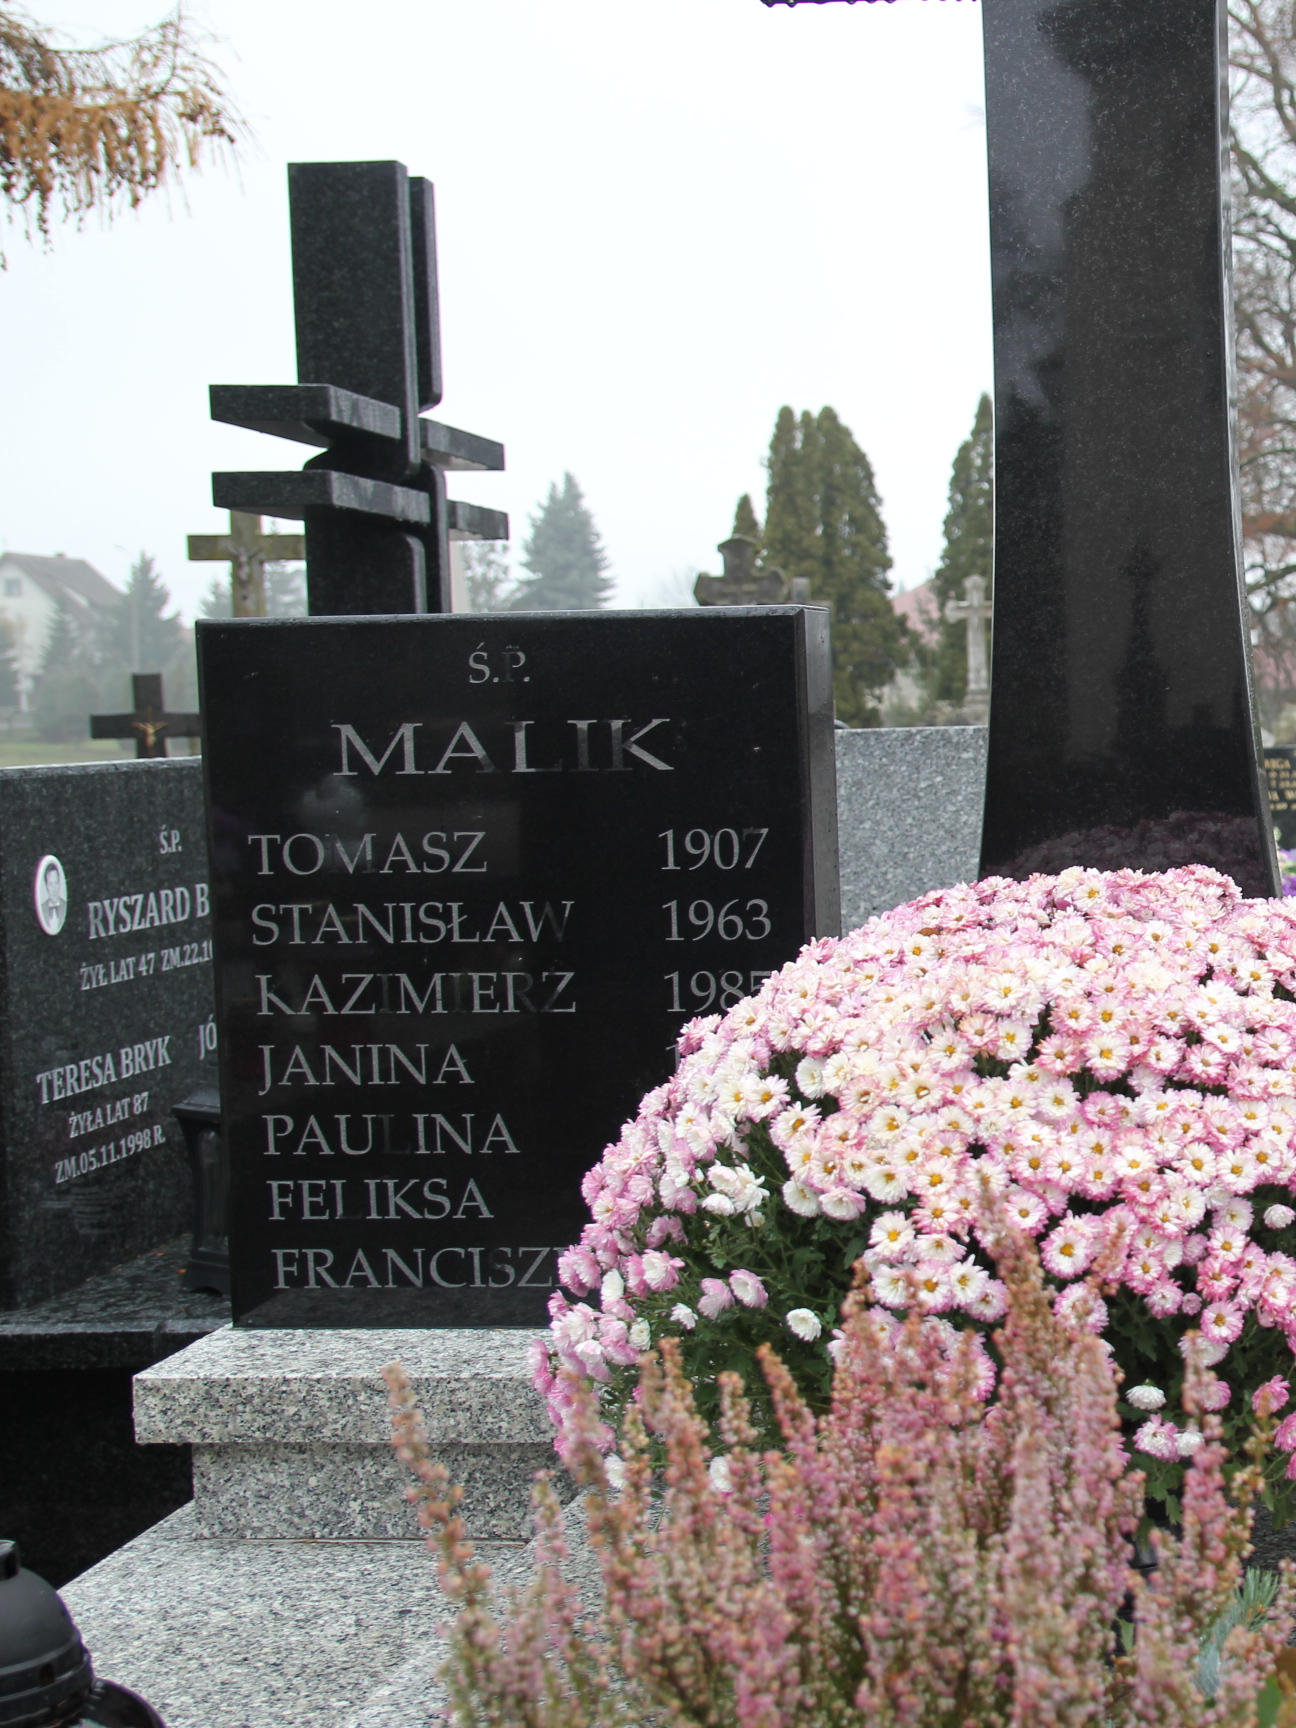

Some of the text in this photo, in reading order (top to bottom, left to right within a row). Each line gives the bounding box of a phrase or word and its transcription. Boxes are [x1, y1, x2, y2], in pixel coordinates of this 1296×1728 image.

[467, 642, 531, 684] Ś.P.
[331, 717, 675, 776] MALIK
[159, 824, 182, 854] Ś.P.
[247, 828, 770, 875] TOMASZ 1907
[88, 886, 191, 939] RYSZARD
[251, 900, 772, 945] STANISŁAW 1963
[80, 961, 108, 991] ŻYŁ
[110, 955, 136, 983] LAT
[138, 952, 155, 977] 47
[255, 971, 577, 1016] KAZIMIERZ
[36, 1036, 172, 1104] TERESA BRYK
[257, 1043, 475, 1096] JANINA
[68, 1091, 149, 1139] ŻYŁA LAT 87
[262, 1112, 520, 1155] PAULINA
[55, 1129, 151, 1184] ZM.05.11.1998
[266, 1178, 494, 1220] FELIKSA
[271, 1247, 569, 1289] FRANCISZ
